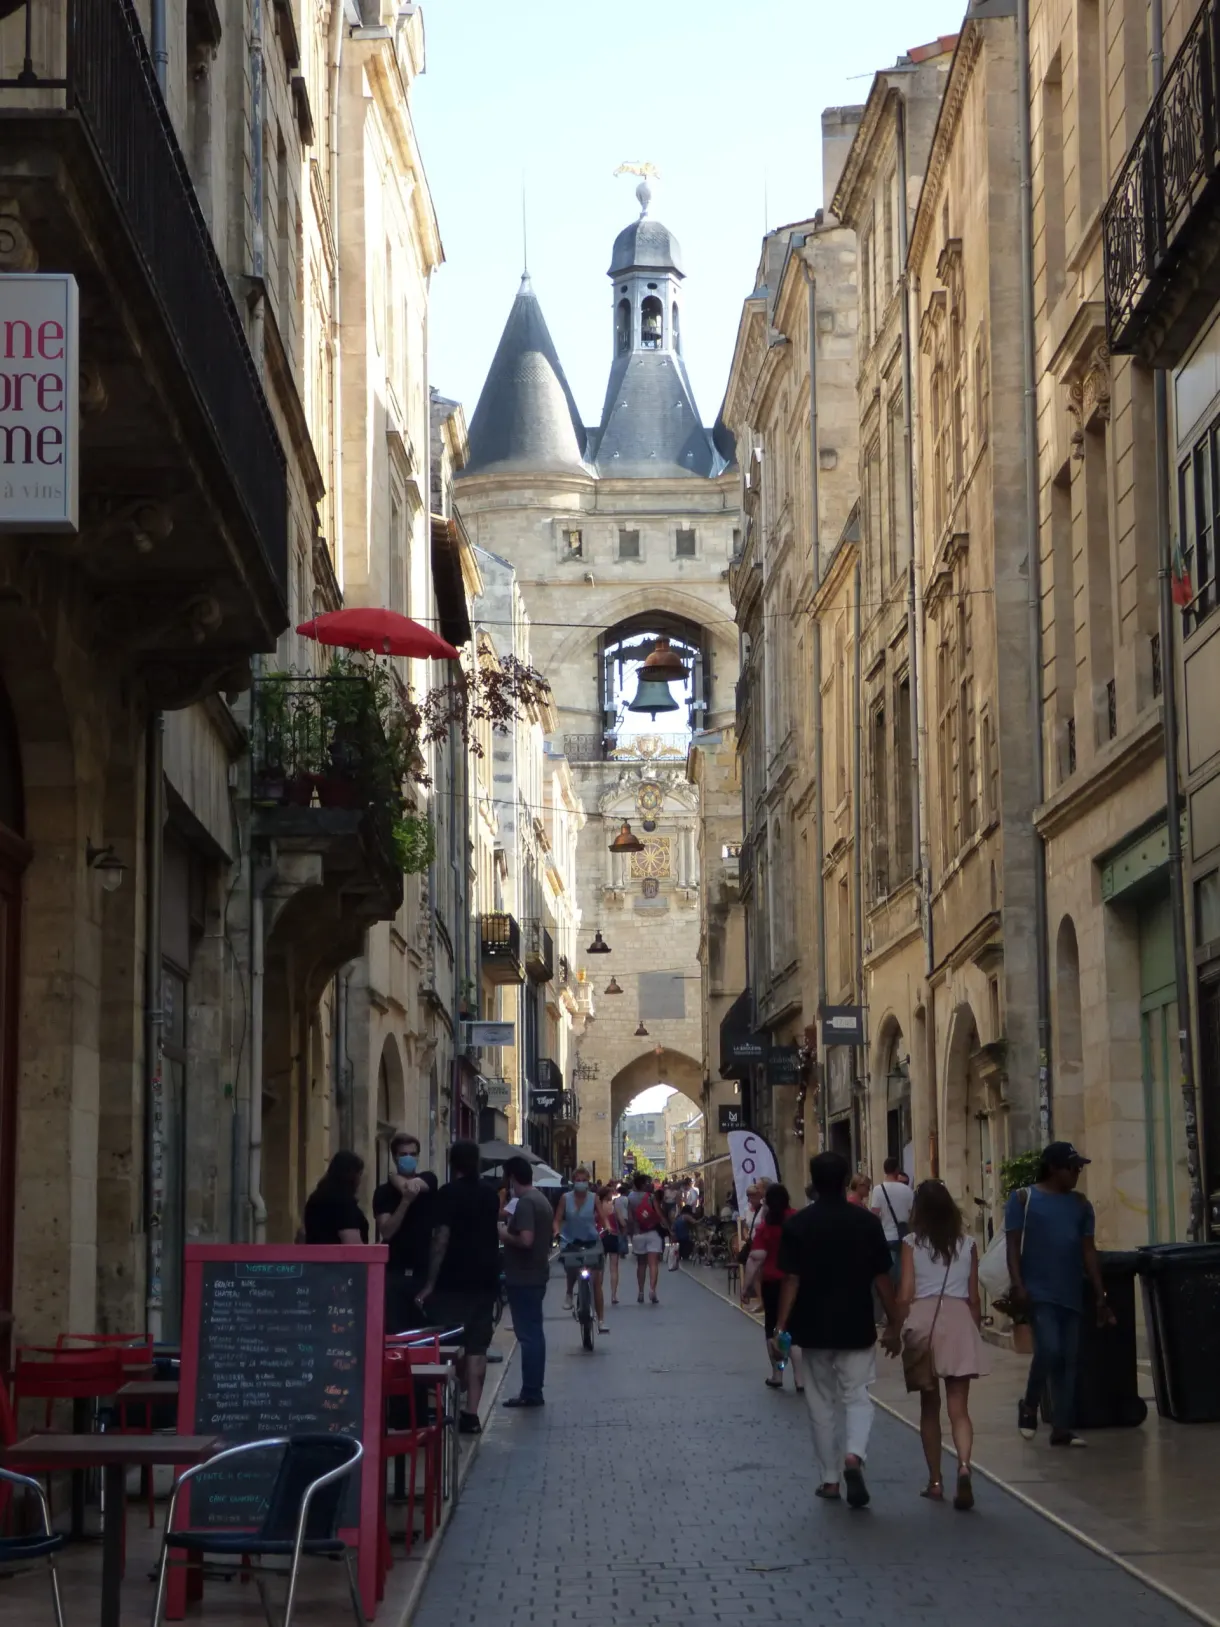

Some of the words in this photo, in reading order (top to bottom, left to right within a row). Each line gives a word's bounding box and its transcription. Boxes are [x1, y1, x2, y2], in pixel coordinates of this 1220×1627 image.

[4, 320, 65, 360] ne
[4, 481, 14, 499] à
[23, 481, 63, 499] vins
